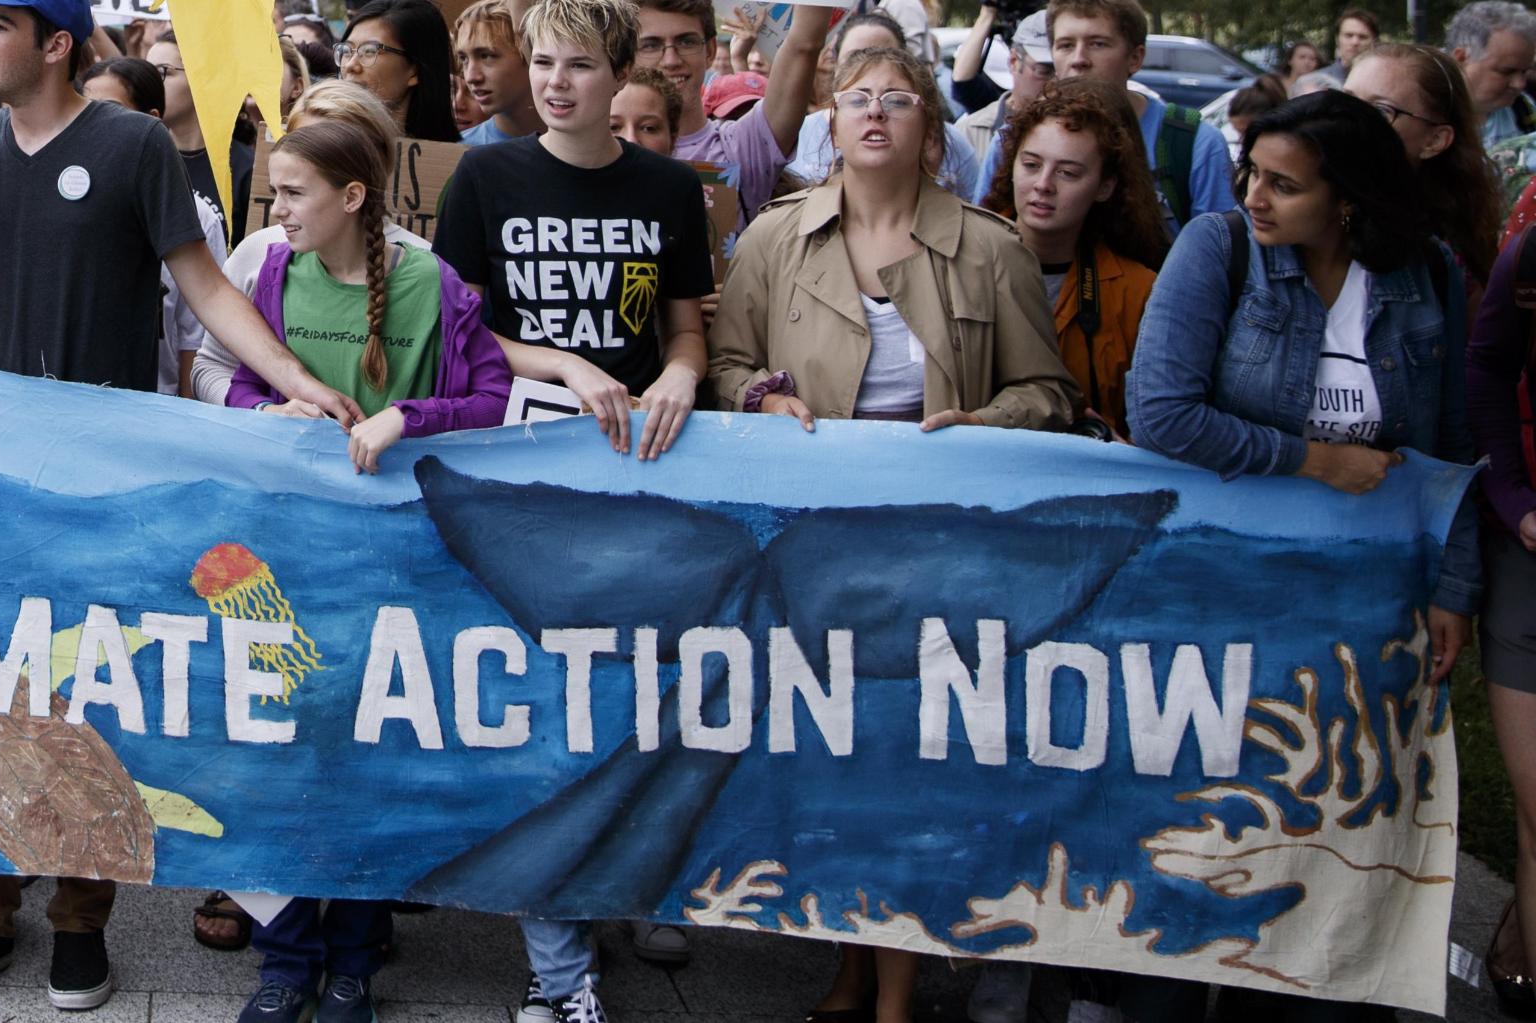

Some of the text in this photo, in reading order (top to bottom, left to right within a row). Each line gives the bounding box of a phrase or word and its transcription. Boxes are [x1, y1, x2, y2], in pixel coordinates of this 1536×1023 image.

[501, 217, 661, 255] GREEN
[505, 261, 614, 300] NEW
[1083, 267, 1092, 301] Nikon
[514, 307, 624, 348] DEAL
[1315, 386, 1364, 413] OUTH
[353, 605, 855, 757] ACTION
[917, 617, 1254, 777] NOW
